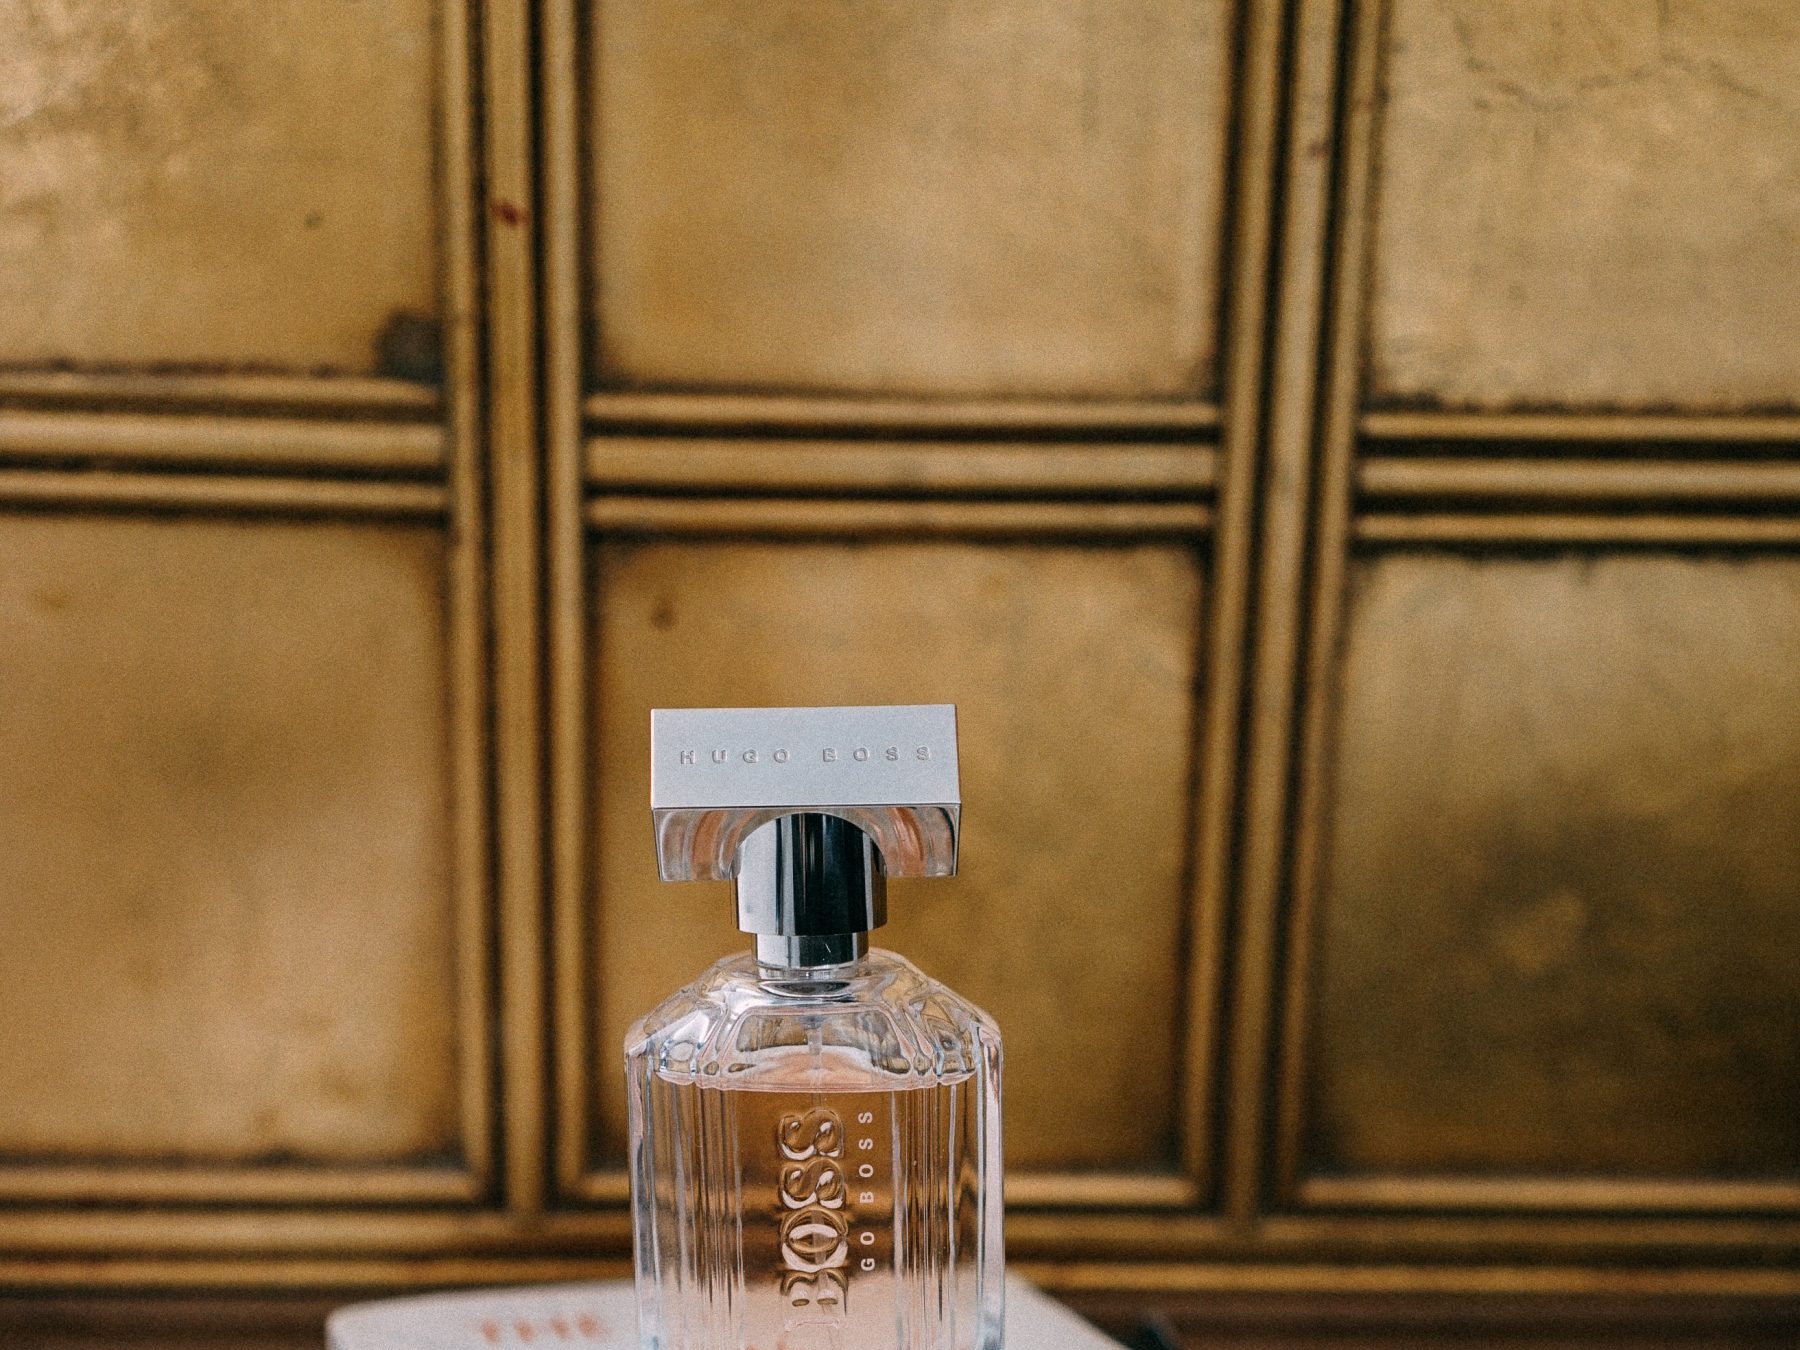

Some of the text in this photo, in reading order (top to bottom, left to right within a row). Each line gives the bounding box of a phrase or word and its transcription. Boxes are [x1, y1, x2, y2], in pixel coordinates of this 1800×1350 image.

[680, 745, 931, 765] HUGO BOSS
[857, 1111, 875, 1204] BOSS
[777, 1108, 849, 1330] BOSS
